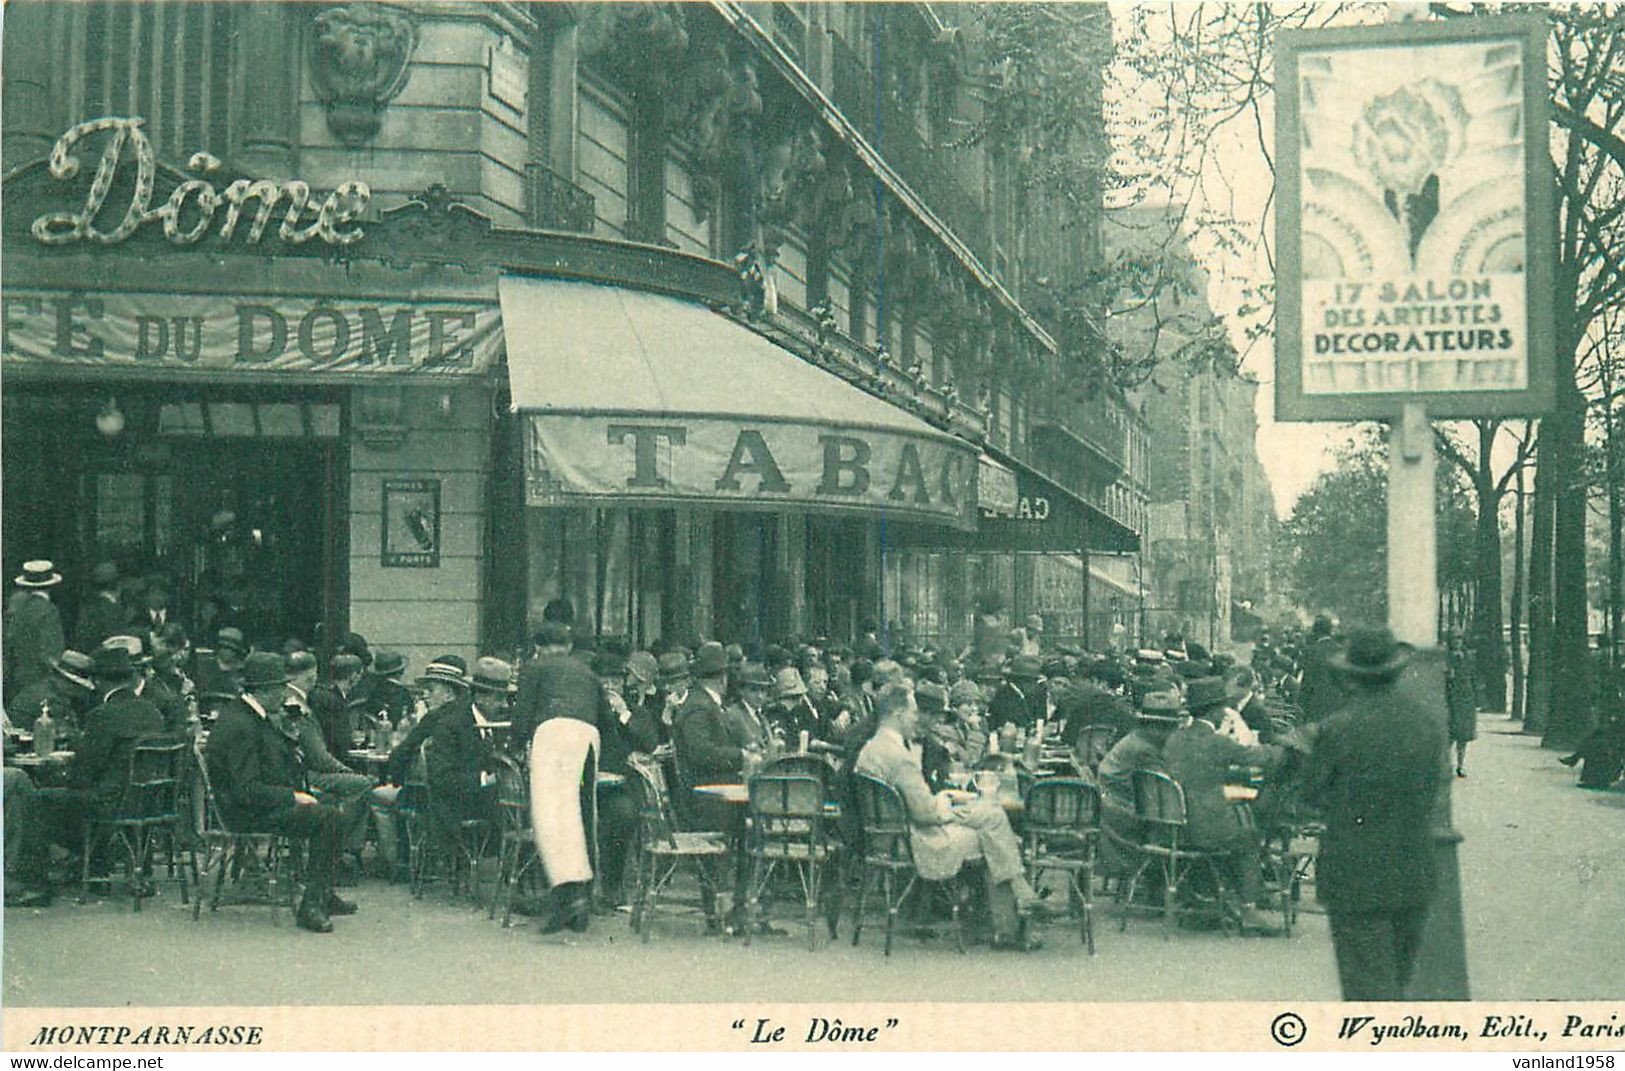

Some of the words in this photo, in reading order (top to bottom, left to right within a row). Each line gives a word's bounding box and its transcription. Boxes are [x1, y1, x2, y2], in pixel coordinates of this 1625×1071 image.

[32, 117, 370, 245] Dôme
[1378, 279, 1491, 303] SALON
[1324, 309, 1365, 328] DES
[1372, 303, 1502, 326] ARTISTES
[136, 316, 204, 361] DU
[236, 303, 475, 367] DÔME
[1315, 329, 1513, 354] DECORATEURS
[30, 1026, 263, 1045] MONTPARNASSE
[1561, 1011, 1625, 1038] Paris
